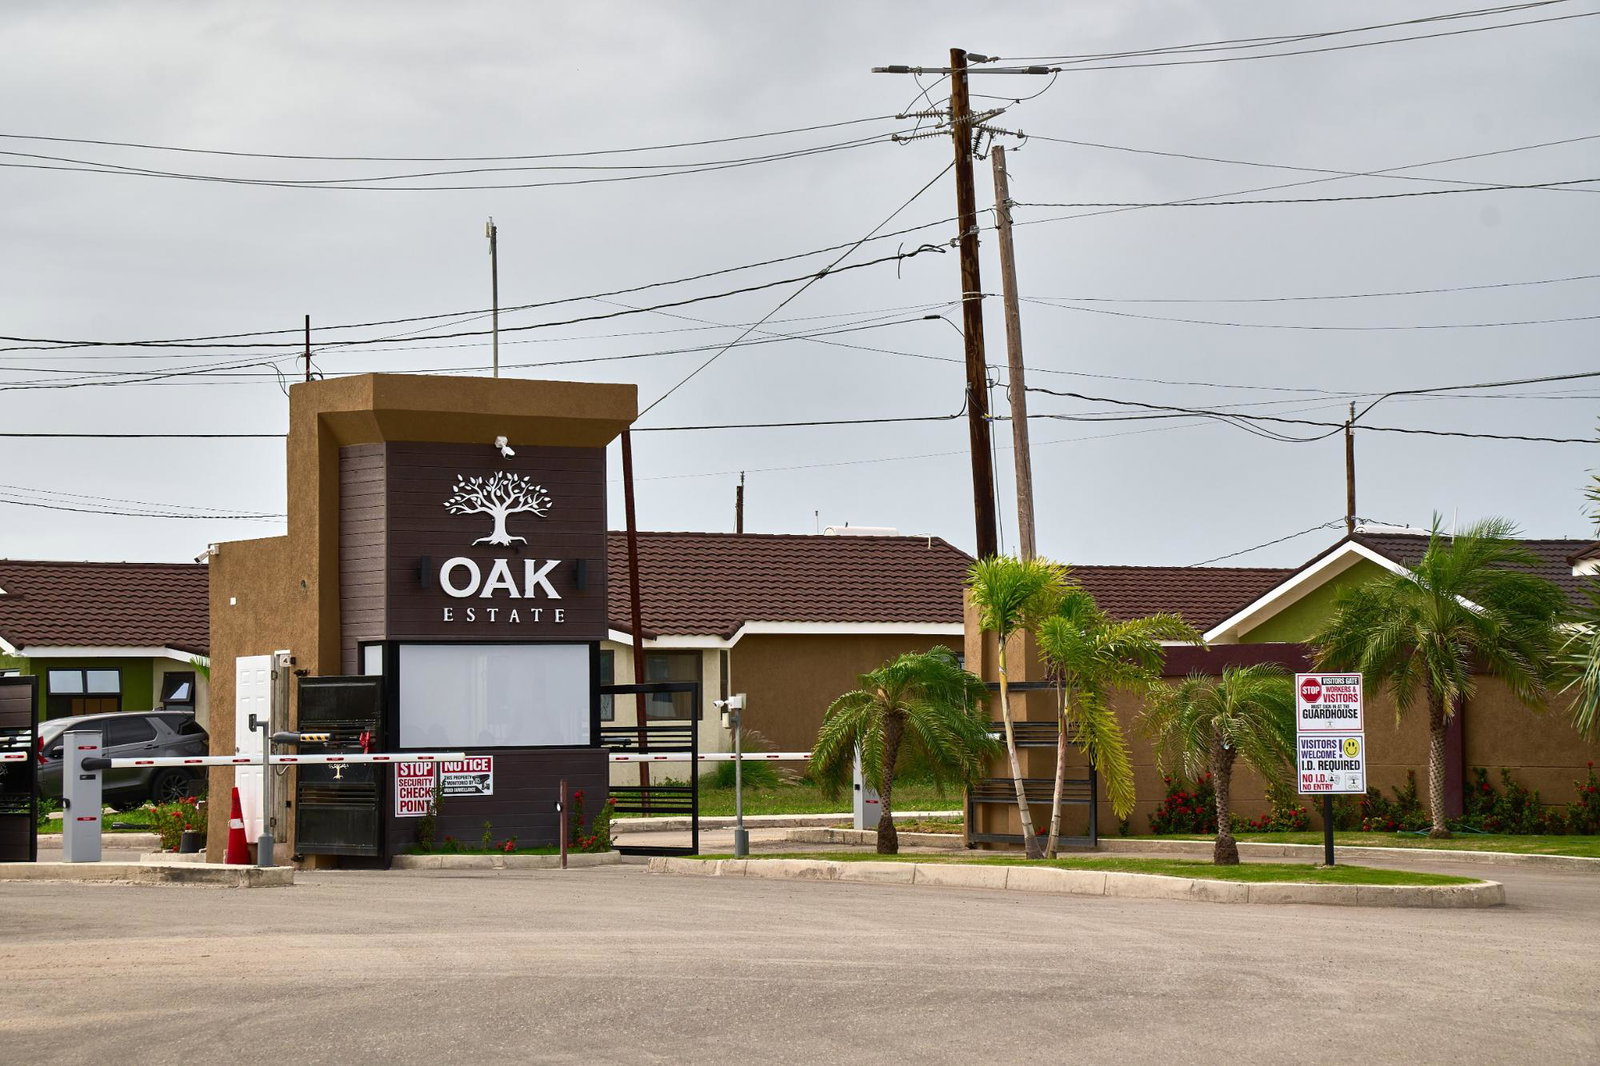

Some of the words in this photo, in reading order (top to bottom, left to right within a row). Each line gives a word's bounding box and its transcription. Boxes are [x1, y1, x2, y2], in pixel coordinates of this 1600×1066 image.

[439, 556, 562, 599] OAK
[443, 607, 565, 623] ESTATE
[1302, 686, 1320, 694] STOP
[1323, 694, 1358, 703] VISITORS
[1302, 709, 1358, 719] GUARDHOUSE
[1301, 740, 1337, 749] VISITORS
[1301, 750, 1337, 759] WELCOME
[400, 762, 432, 776] STOP
[444, 758, 489, 772] NOTICE
[1302, 760, 1316, 770] I.D.
[1318, 760, 1360, 772] REQUIRED
[398, 778, 433, 787] SECURITY
[1302, 774, 1313, 782] NO
[1316, 774, 1328, 782] I.D.
[400, 788, 432, 799] CHECK
[400, 800, 432, 812] POINT
